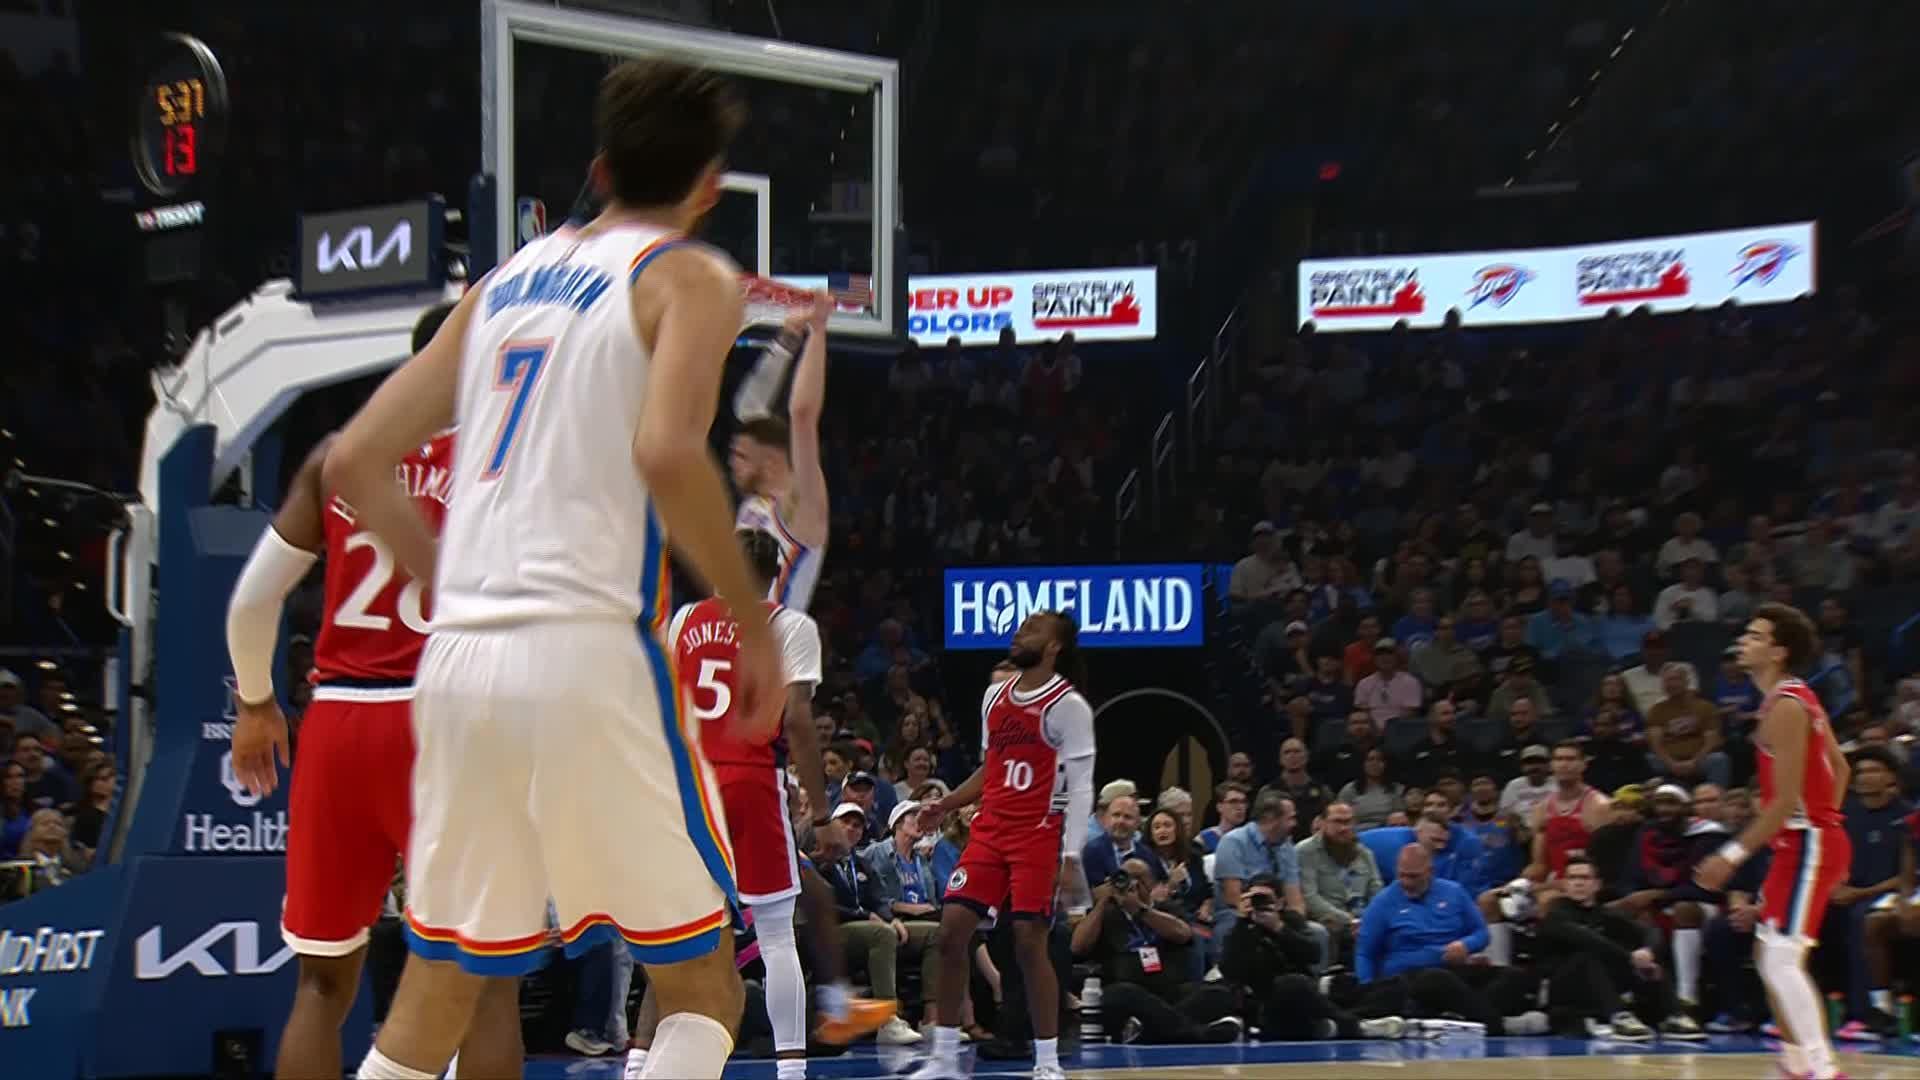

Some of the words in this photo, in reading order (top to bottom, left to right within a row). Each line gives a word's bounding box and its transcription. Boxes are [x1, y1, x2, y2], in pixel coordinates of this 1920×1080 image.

[165, 124, 196, 175] 13
[316, 218, 411, 273] KIA
[1032, 280, 1135, 298] SPECTRUM
[1310, 267, 1419, 289] SPECTRUM
[1311, 282, 1399, 306] PAINT
[967, 287, 1013, 307] UP
[1033, 296, 1113, 317] PAINT
[480, 337, 554, 482] 7
[683, 621, 739, 654] JONES
[693, 659, 731, 719] 5
[1003, 759, 1033, 791] 10
